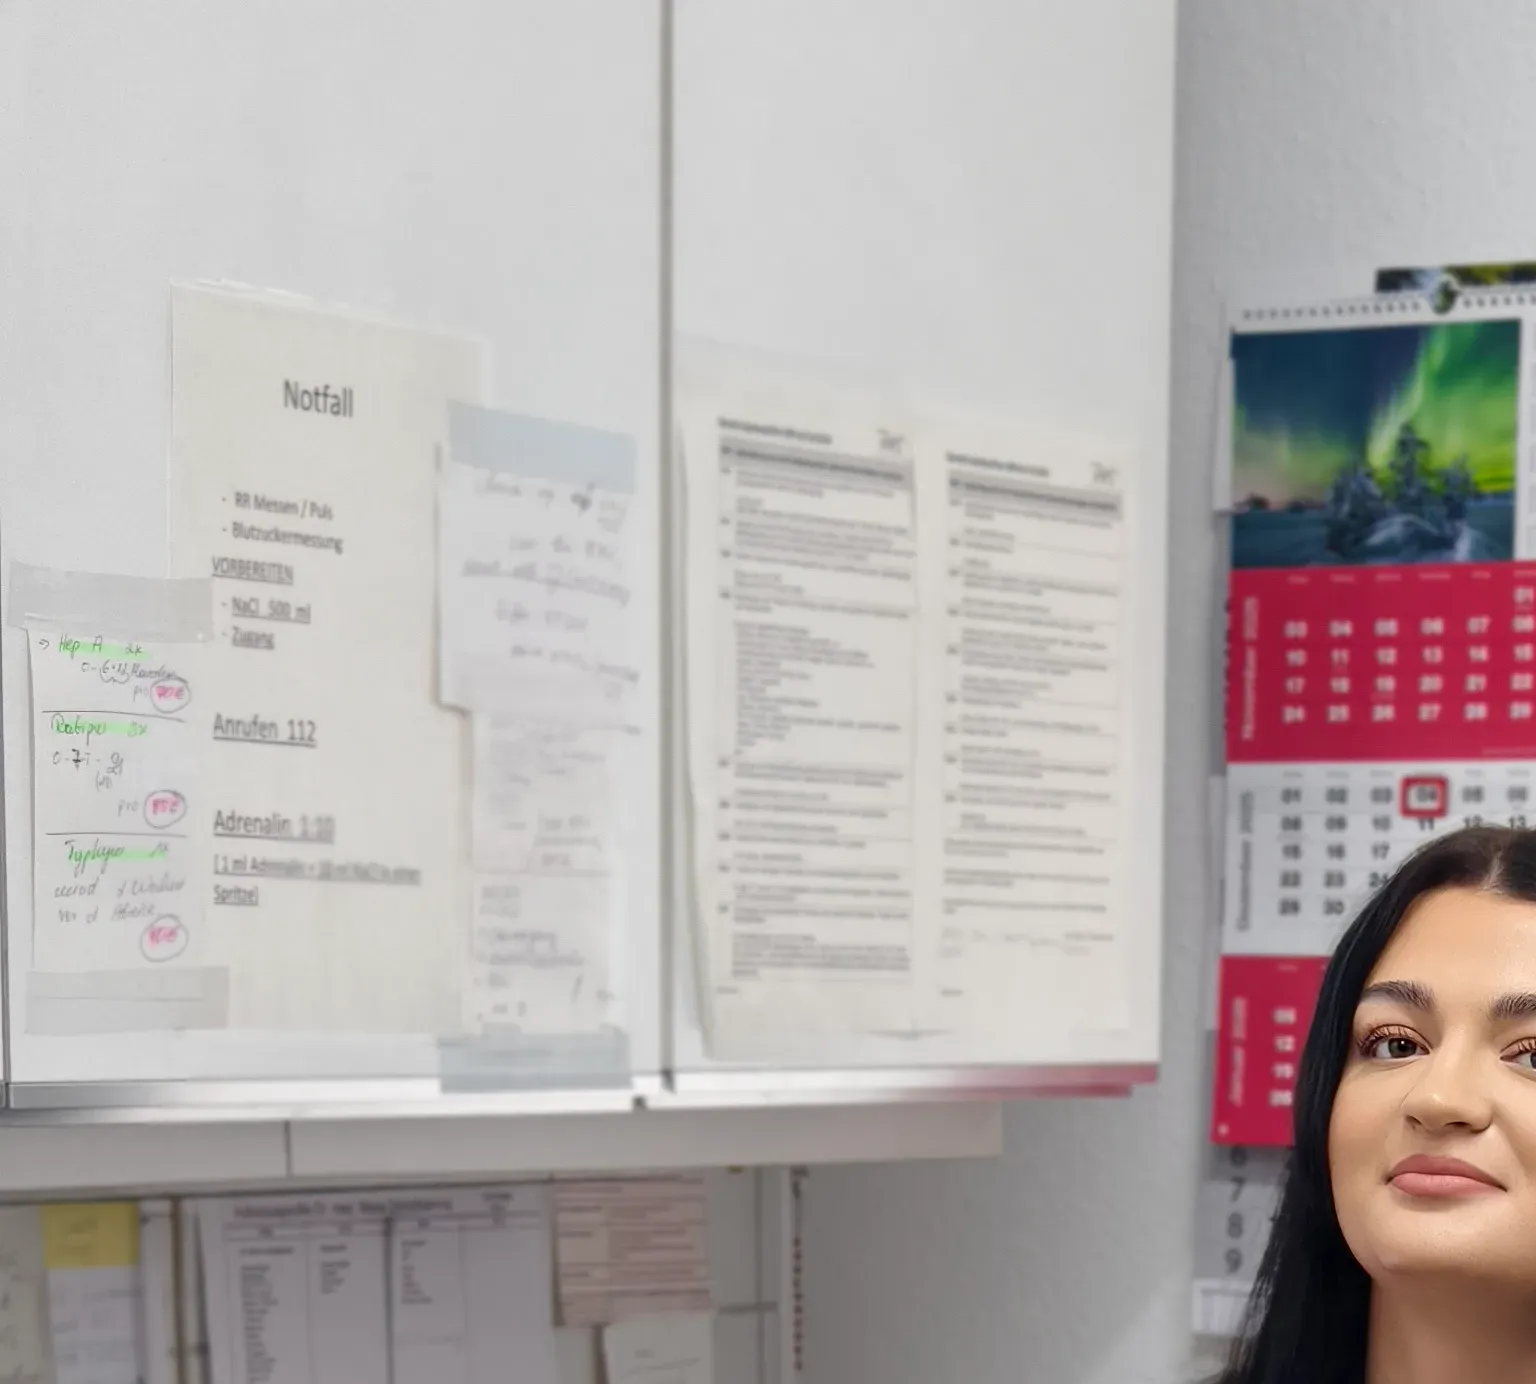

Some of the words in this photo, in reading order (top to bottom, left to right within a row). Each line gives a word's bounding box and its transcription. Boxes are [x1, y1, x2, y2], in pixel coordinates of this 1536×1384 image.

[282, 379, 354, 418] Notfall
[252, 493, 299, 515] Messen
[308, 501, 334, 521] Puls
[231, 520, 343, 555] Blutzuckermessung
[211, 556, 294, 585] VORBEREITEN
[213, 713, 279, 742] Anrufen
[287, 718, 317, 746] 112
[213, 809, 293, 837] Adrenalin
[1370, 842, 1391, 862] 17
